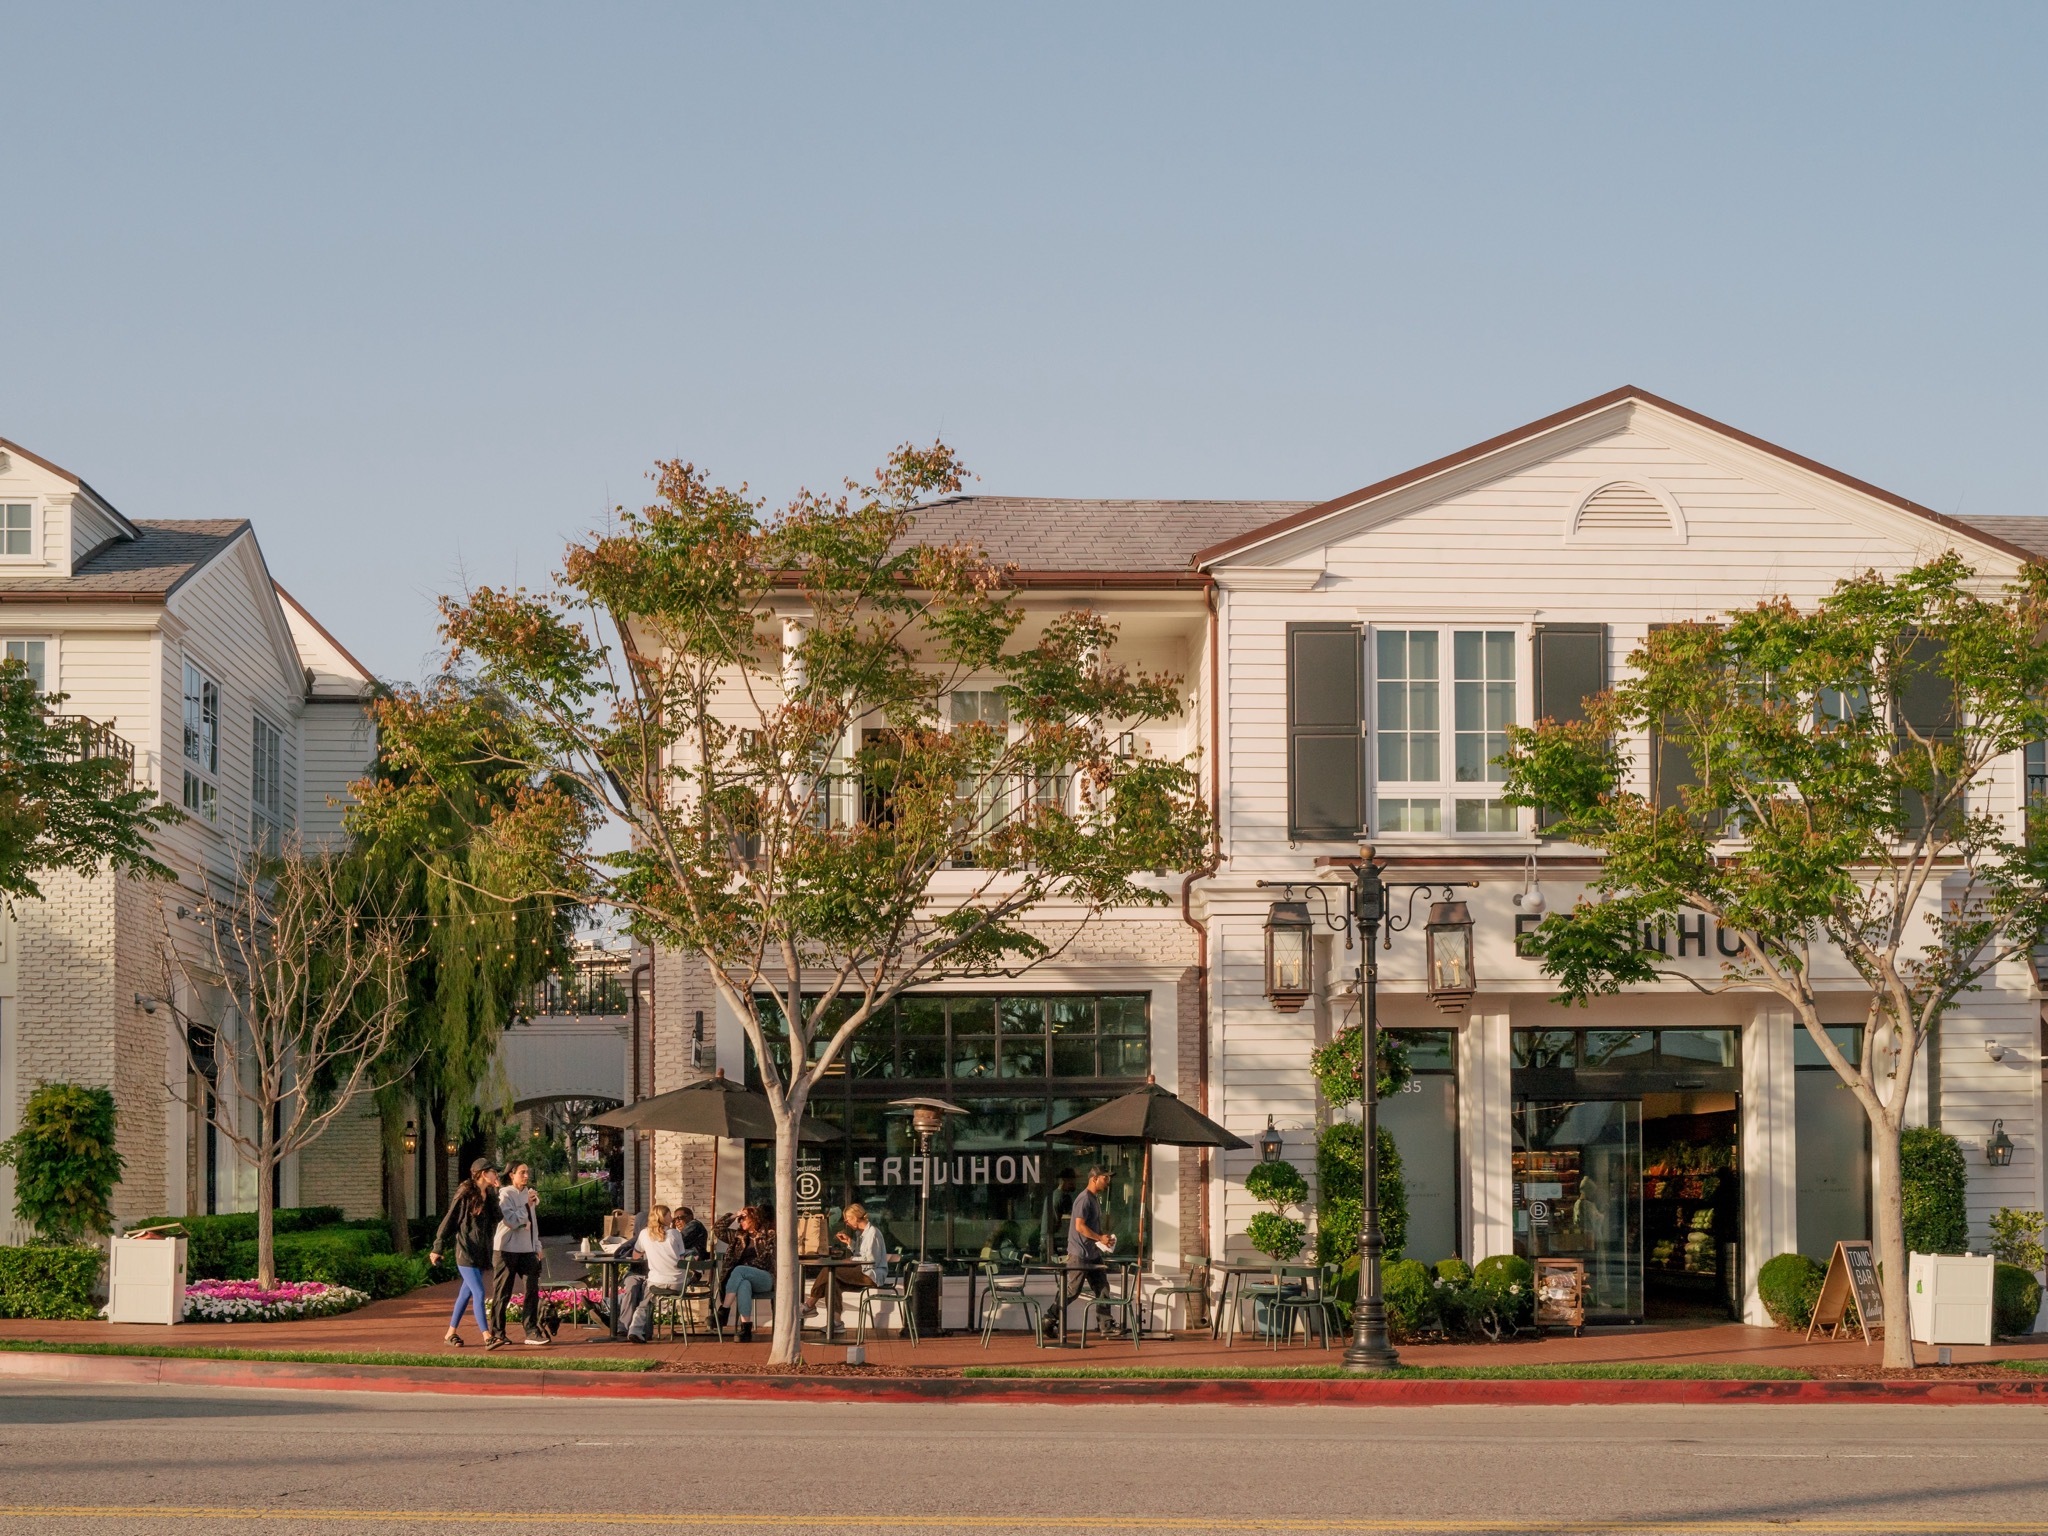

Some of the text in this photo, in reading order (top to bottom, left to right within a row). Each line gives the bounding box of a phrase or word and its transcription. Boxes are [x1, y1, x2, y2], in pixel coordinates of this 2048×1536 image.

[858, 1155, 1041, 1186] EREWHON
[801, 1178, 815, 1195] B
[1534, 1204, 1544, 1216] B
[1848, 1251, 1872, 1267] TONIC
[1856, 1269, 1874, 1285] BAR
